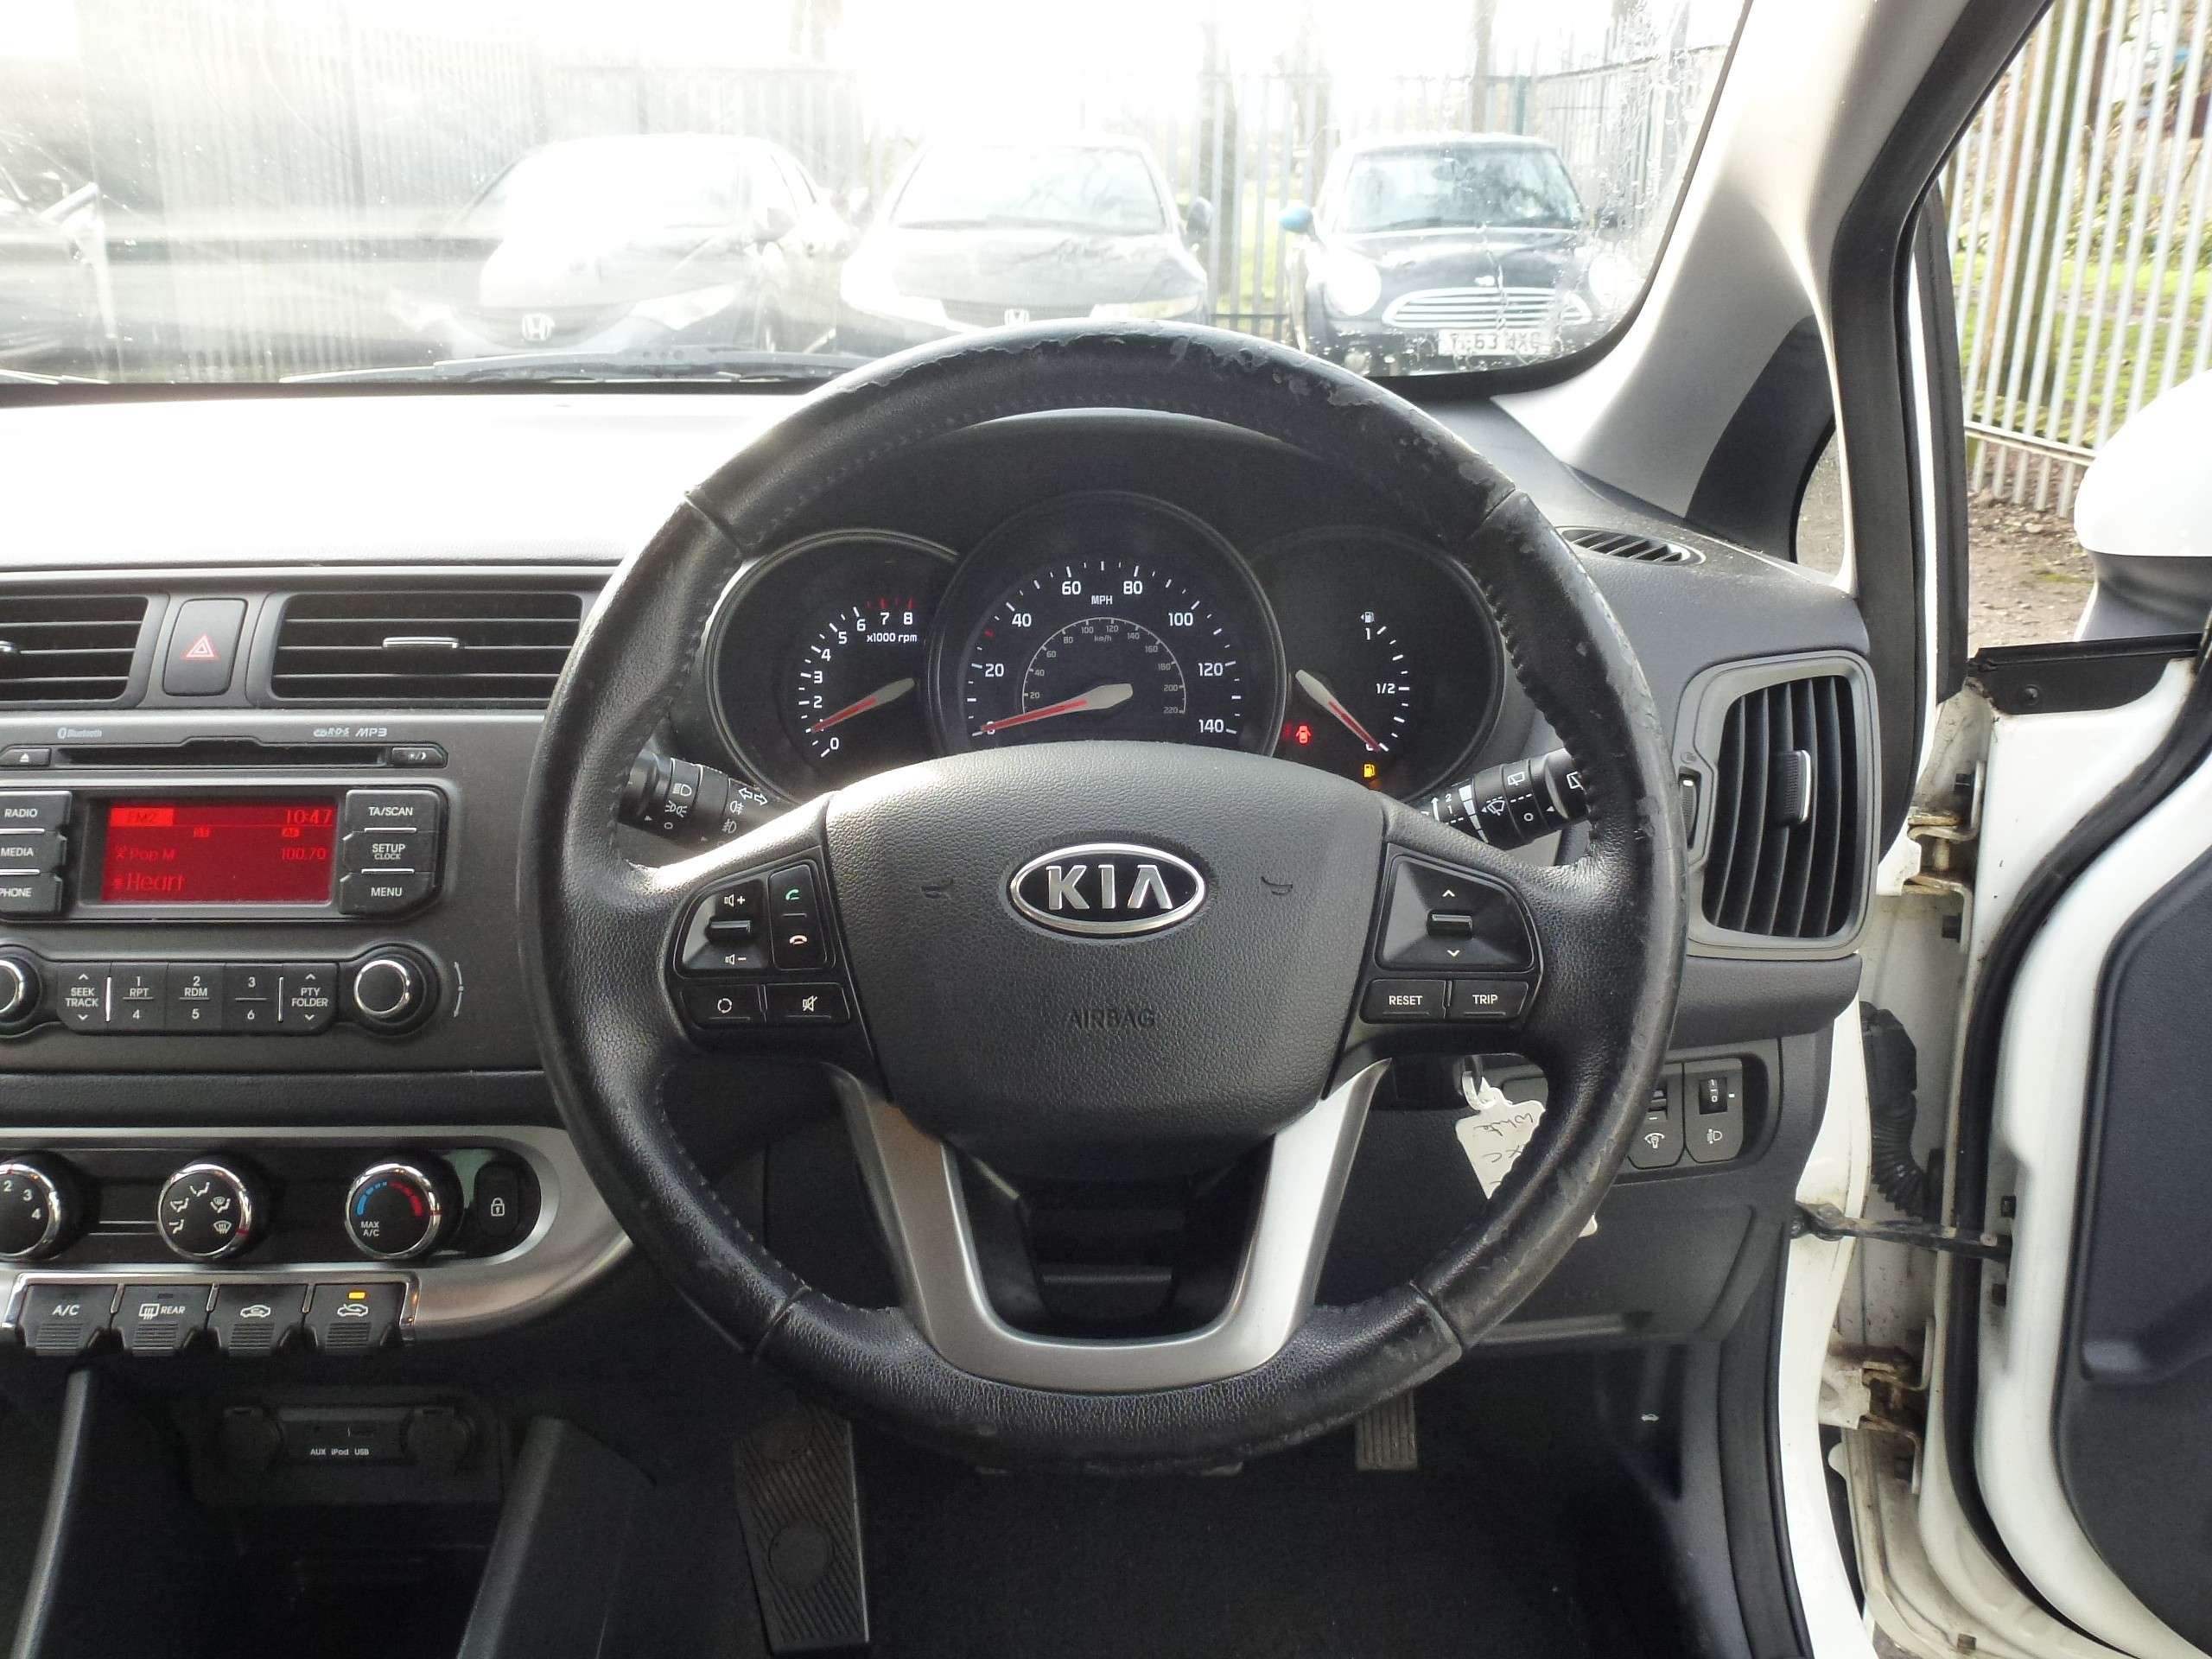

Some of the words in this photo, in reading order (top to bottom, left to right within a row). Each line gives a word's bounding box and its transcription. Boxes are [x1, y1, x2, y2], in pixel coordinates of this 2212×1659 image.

[1061, 581, 1081, 595] 60
[1123, 581, 1142, 595] 80
[1091, 595, 1113, 605] MPH
[880, 612, 890, 625] 7
[903, 612, 913, 625] 8
[1012, 613, 1032, 627] 40
[1168, 613, 1193, 626] 100
[856, 619, 866, 632] 6
[838, 632, 848, 645] 5
[867, 632, 896, 643] x1000
[898, 633, 918, 644] rpm
[1365, 628, 1371, 640] 1
[821, 649, 831, 661] 4
[985, 663, 1005, 677] 20
[1198, 663, 1223, 677] 120
[813, 671, 823, 683] 3
[1376, 683, 1395, 695] 1/2
[813, 696, 823, 709] 2
[1198, 719, 1224, 733] 140
[355, 728, 388, 737] MP3
[830, 737, 840, 750] 0
[1445, 794, 1452, 803] 2
[4, 808, 38, 817] RADIO
[286, 810, 333, 824] 10:47
[368, 806, 414, 817] TA/SCAN
[0, 848, 34, 857] MEDIA
[372, 843, 406, 853] SETUP
[281, 848, 327, 861] 100.70
[127, 874, 185, 891] Heart
[1046, 865, 1173, 910] KIA
[371, 887, 403, 897] MENU
[137, 976, 141, 986] 1
[193, 976, 200, 987] 2
[248, 976, 256, 988] 3
[70, 987, 95, 996] SEEK
[129, 988, 149, 997] RPT
[184, 988, 208, 997] RDM
[301, 987, 321, 996] PTY
[64, 997, 99, 1007] TRACK
[291, 997, 328, 1007] FOLDER
[1389, 995, 1422, 1006] RESET
[1472, 995, 1498, 1005] TRIP
[132, 1009, 140, 1020] 4
[192, 1008, 200, 1020] 5
[247, 1009, 255, 1020] 6
[1067, 1009, 1155, 1029] AIRBAG
[3, 1180, 12, 1192] 2
[22, 1189, 32, 1201] 3
[31, 1208, 41, 1220] 4
[52, 1303, 79, 1317] A/C
[161, 1305, 186, 1315] REAR
